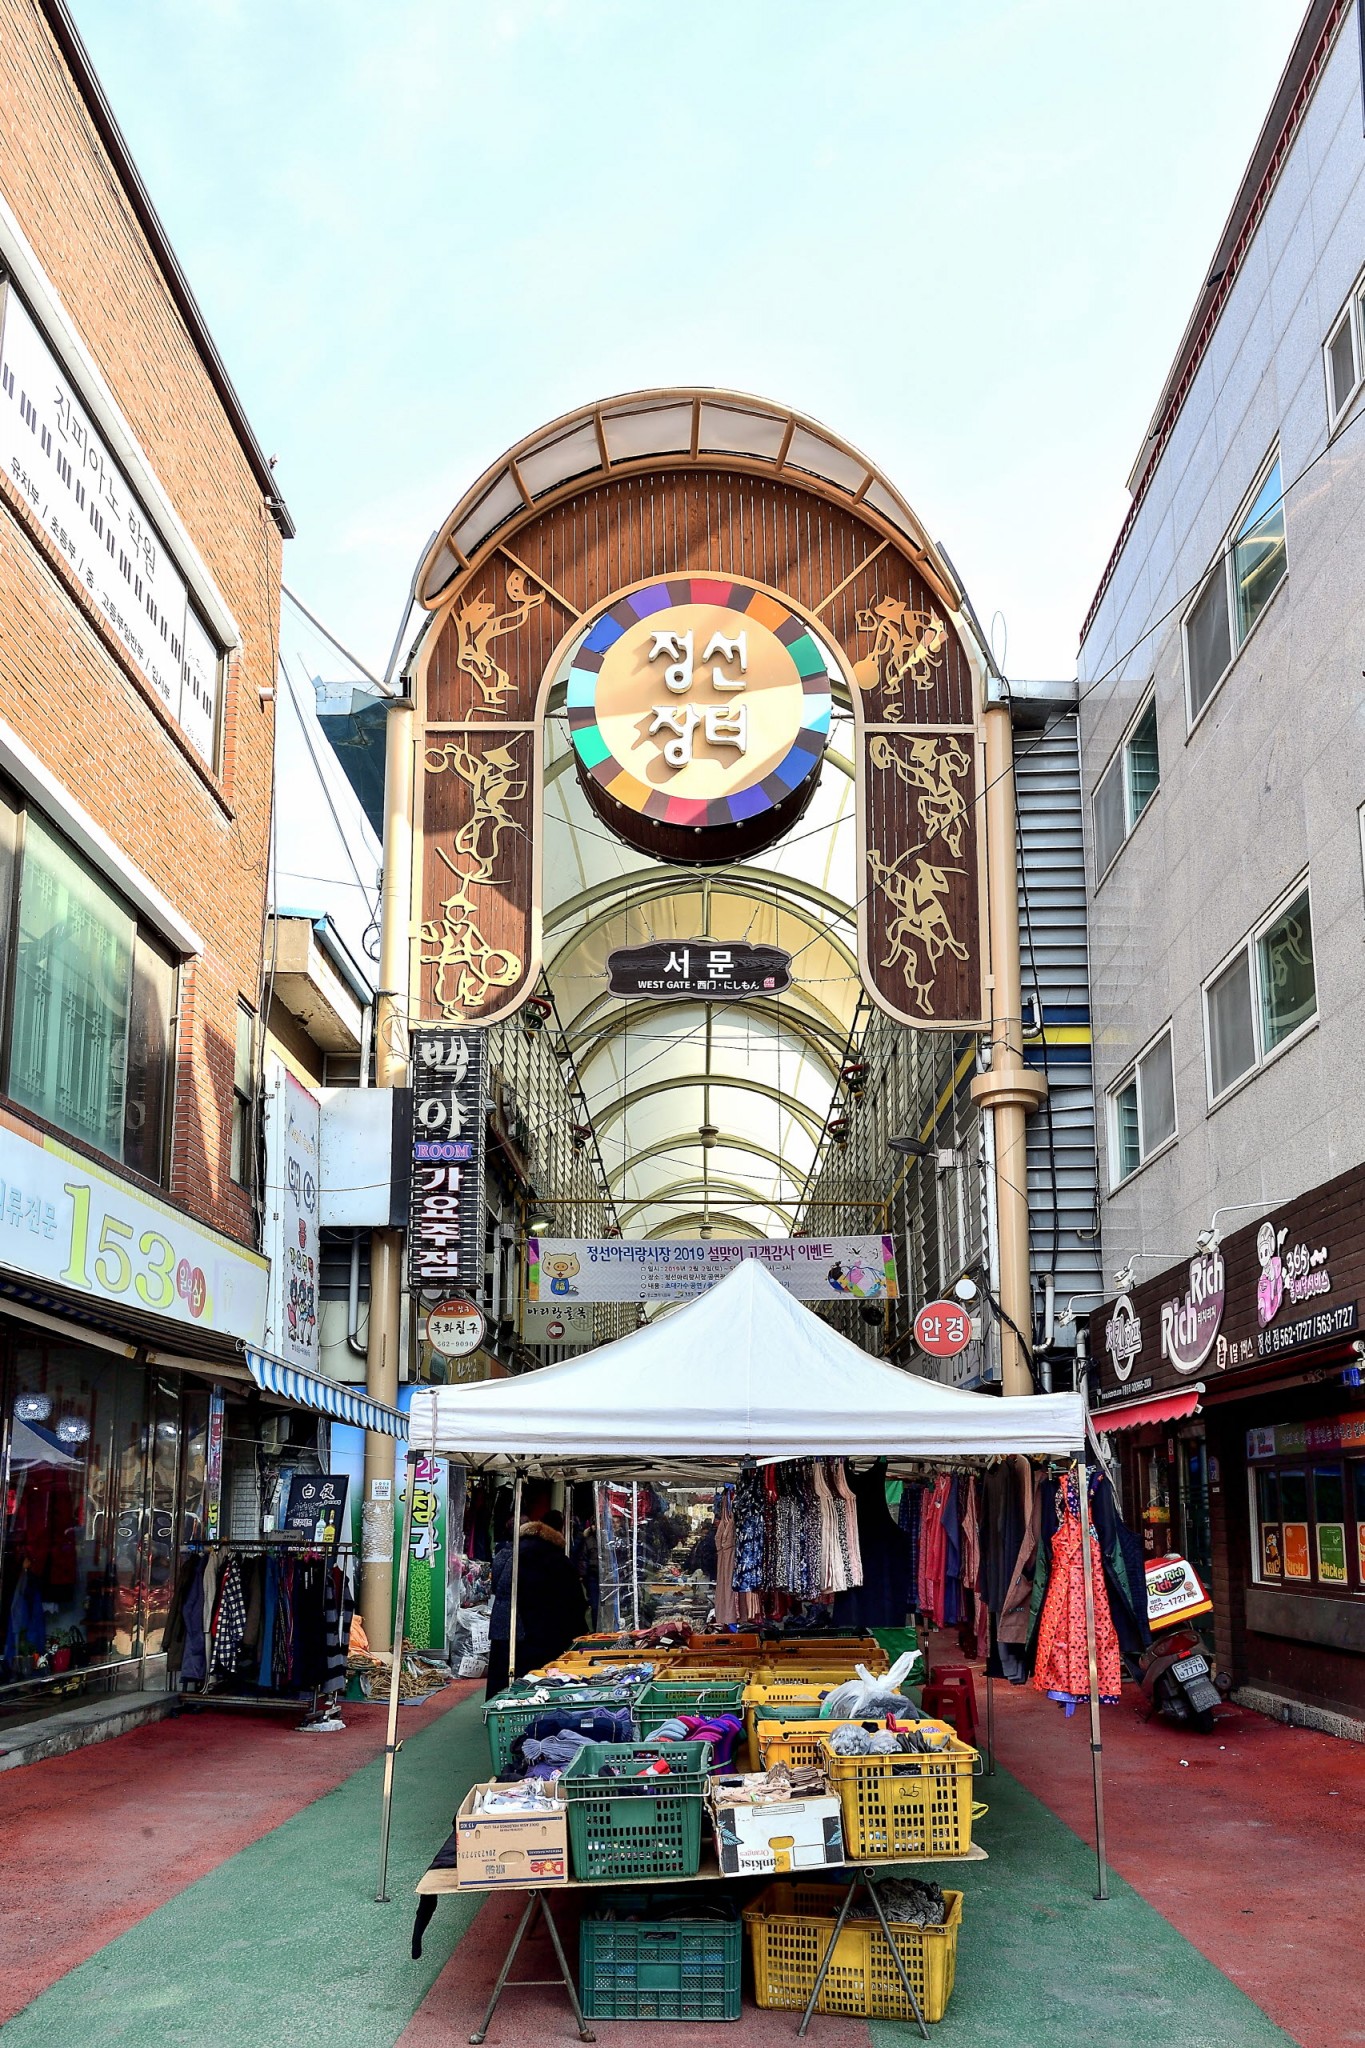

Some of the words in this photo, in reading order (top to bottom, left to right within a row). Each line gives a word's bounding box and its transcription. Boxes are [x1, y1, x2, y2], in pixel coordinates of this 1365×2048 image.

[10, 456, 40, 506] 유치부
[50, 516, 77, 560] 초등부
[128, 506, 156, 584] 학원
[648, 627, 749, 694] 정선
[648, 703, 749, 769] 장터
[663, 949, 735, 979] 서문
[637, 980, 664, 989] WEST
[666, 980, 691, 989] GATE
[723, 980, 760, 990] にしもん
[418, 1036, 471, 1139] 백야
[417, 1143, 470, 1159] ROOM
[418, 1166, 464, 1278] 가요주점
[60, 1182, 176, 1310] 153
[586, 1245, 671, 1263] 정선아리랑시장
[673, 1246, 705, 1261] 2019
[707, 1246, 744, 1262] 설맞이
[747, 1244, 796, 1262] 고객감사
[797, 1243, 835, 1261] 이벤트
[1286, 1243, 1310, 1277] 365
[1190, 1251, 1223, 1306] Rich
[430, 1320, 478, 1335] 목화침구
[527, 1306, 587, 1321] 아리랑골목
[1161, 1296, 1198, 1356] Rich
[1279, 1319, 1313, 1348] 562-1727
[1316, 1305, 1354, 1336] 563-1727
[921, 1316, 964, 1342] 안경
[1147, 1579, 1172, 1596] Rich
[1164, 1566, 1185, 1581] Rich
[1149, 1593, 1187, 1613] 562-1727
[1183, 1663, 1204, 1676] 7779
[740, 1849, 769, 1857] Oranges
[530, 1859, 564, 1876] Dole
